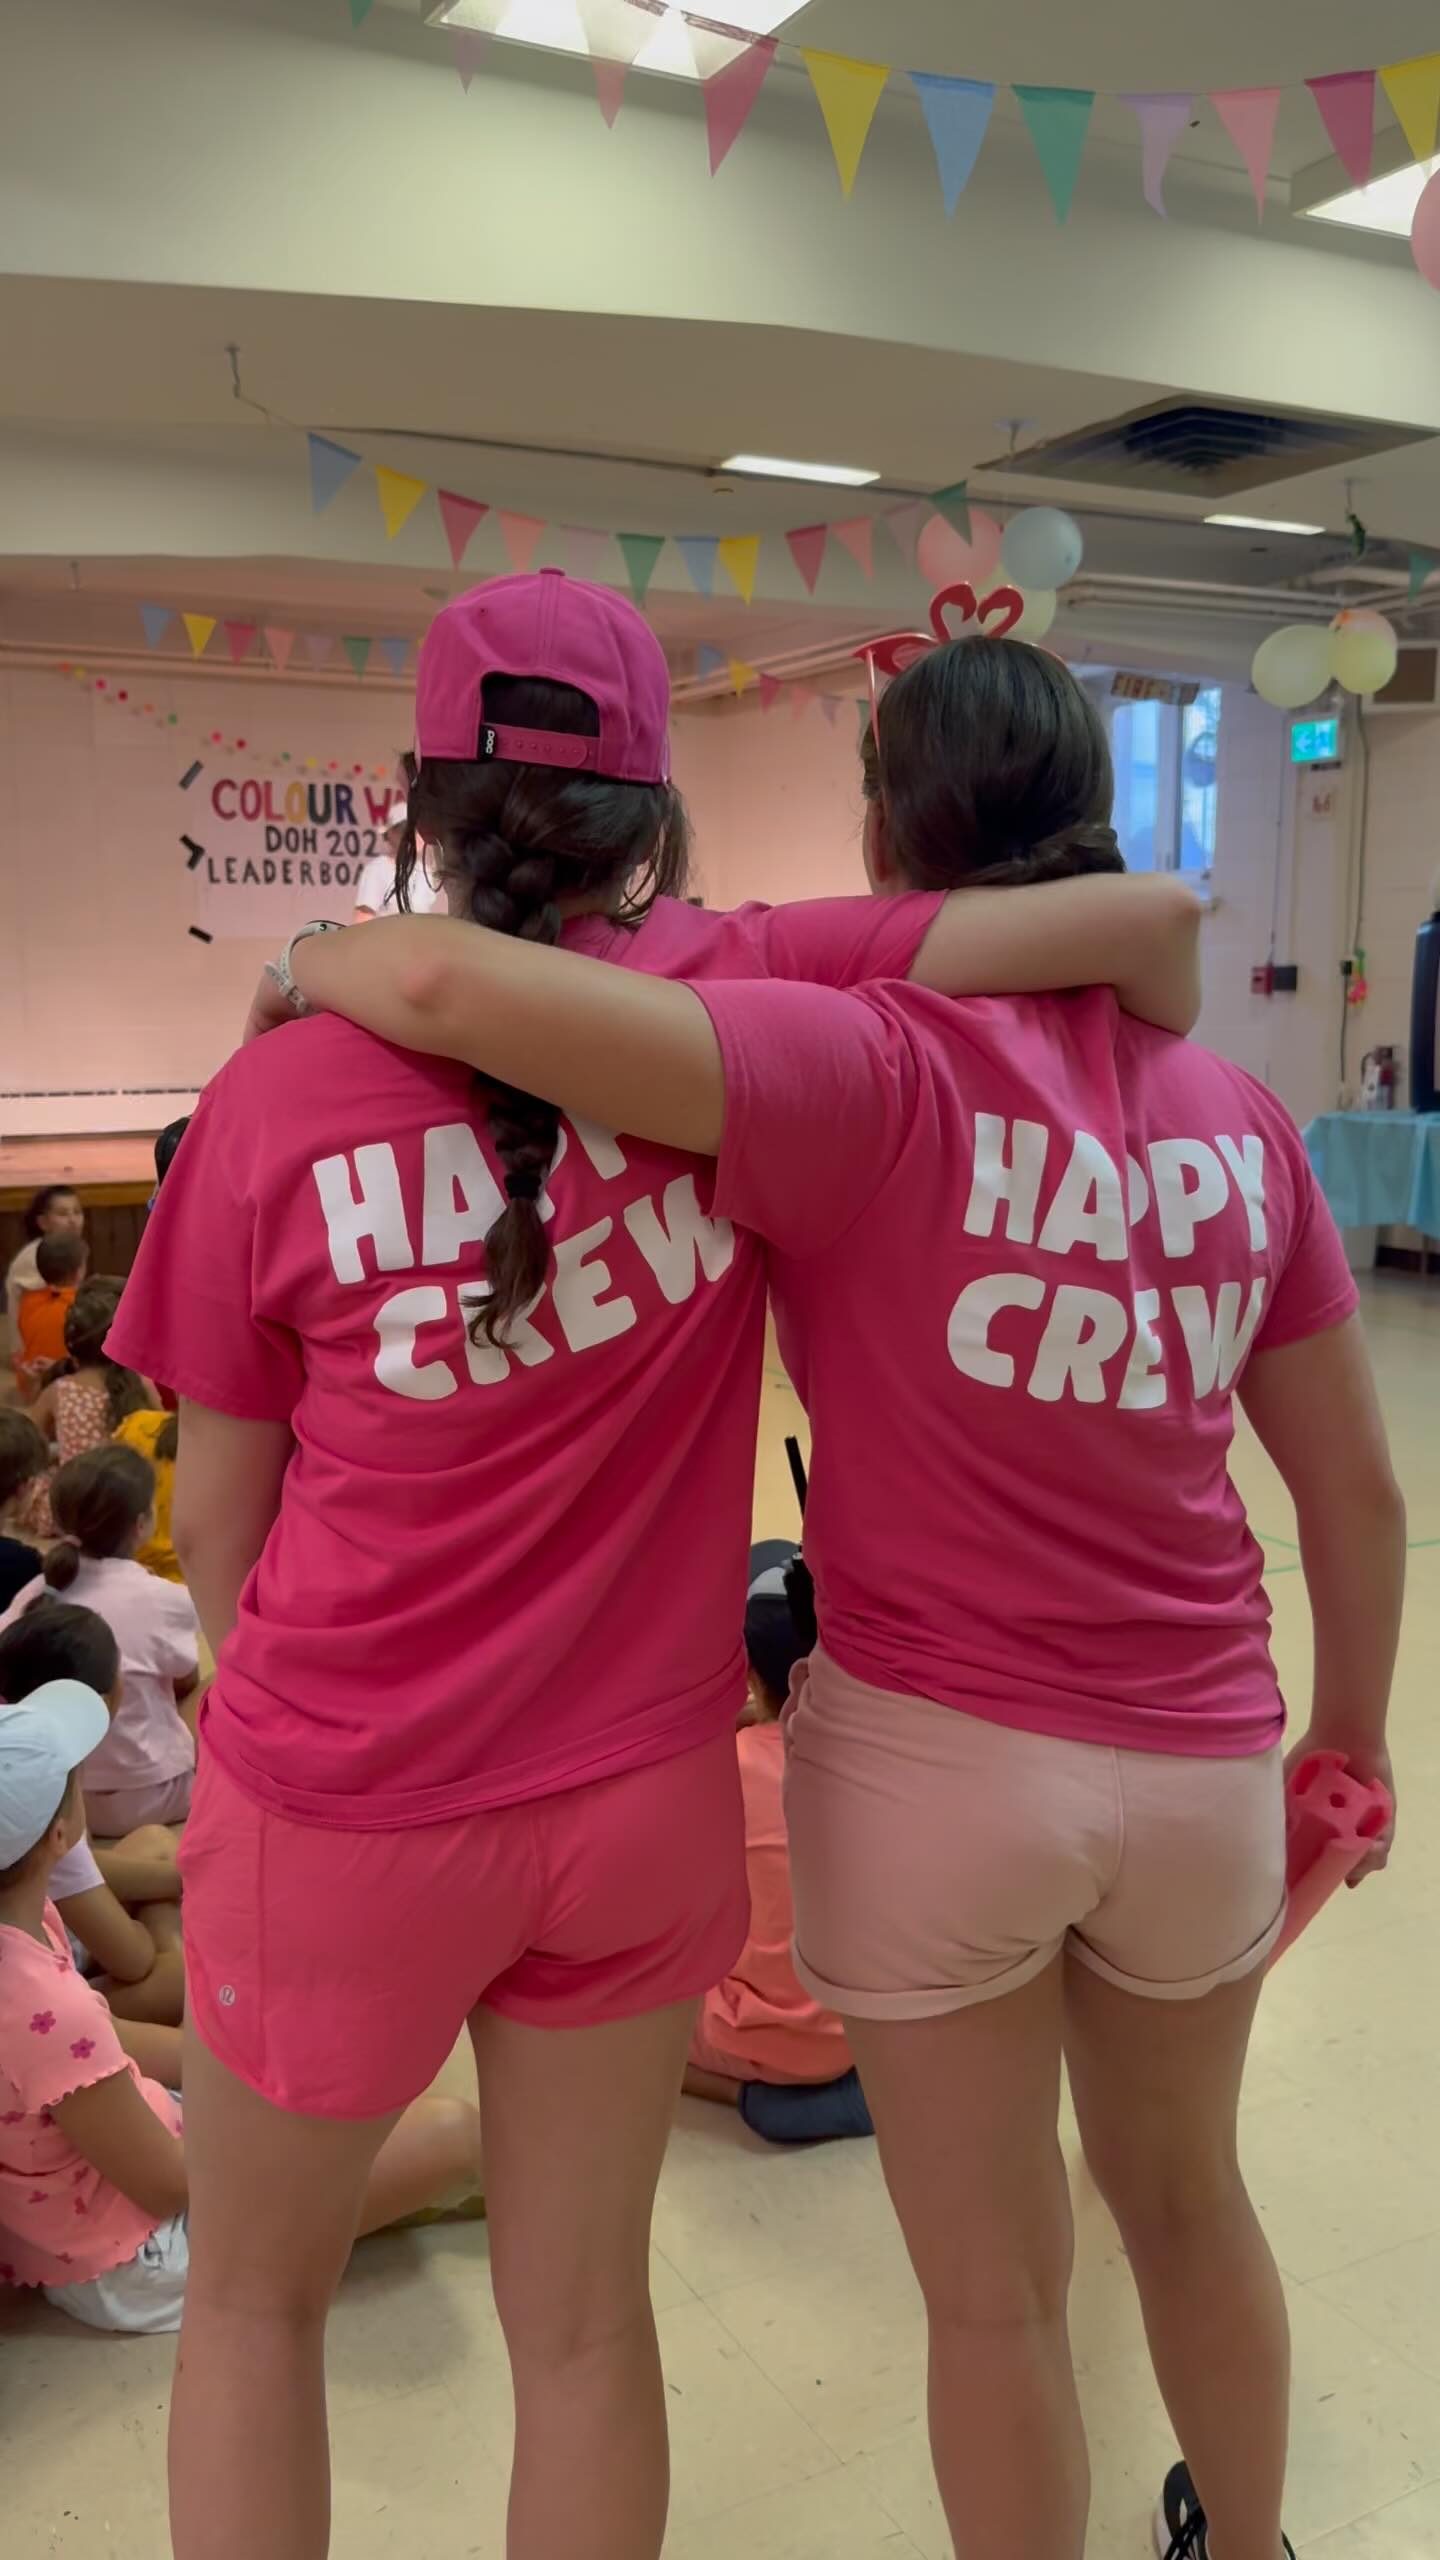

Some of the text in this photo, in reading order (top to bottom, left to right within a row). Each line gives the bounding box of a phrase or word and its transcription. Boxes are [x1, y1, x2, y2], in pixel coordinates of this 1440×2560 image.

[212, 779, 358, 825] COLOUR
[265, 825, 380, 857] DOH 202
[373, 1174, 735, 1400] CREW
[947, 1272, 1266, 1409] CREW
